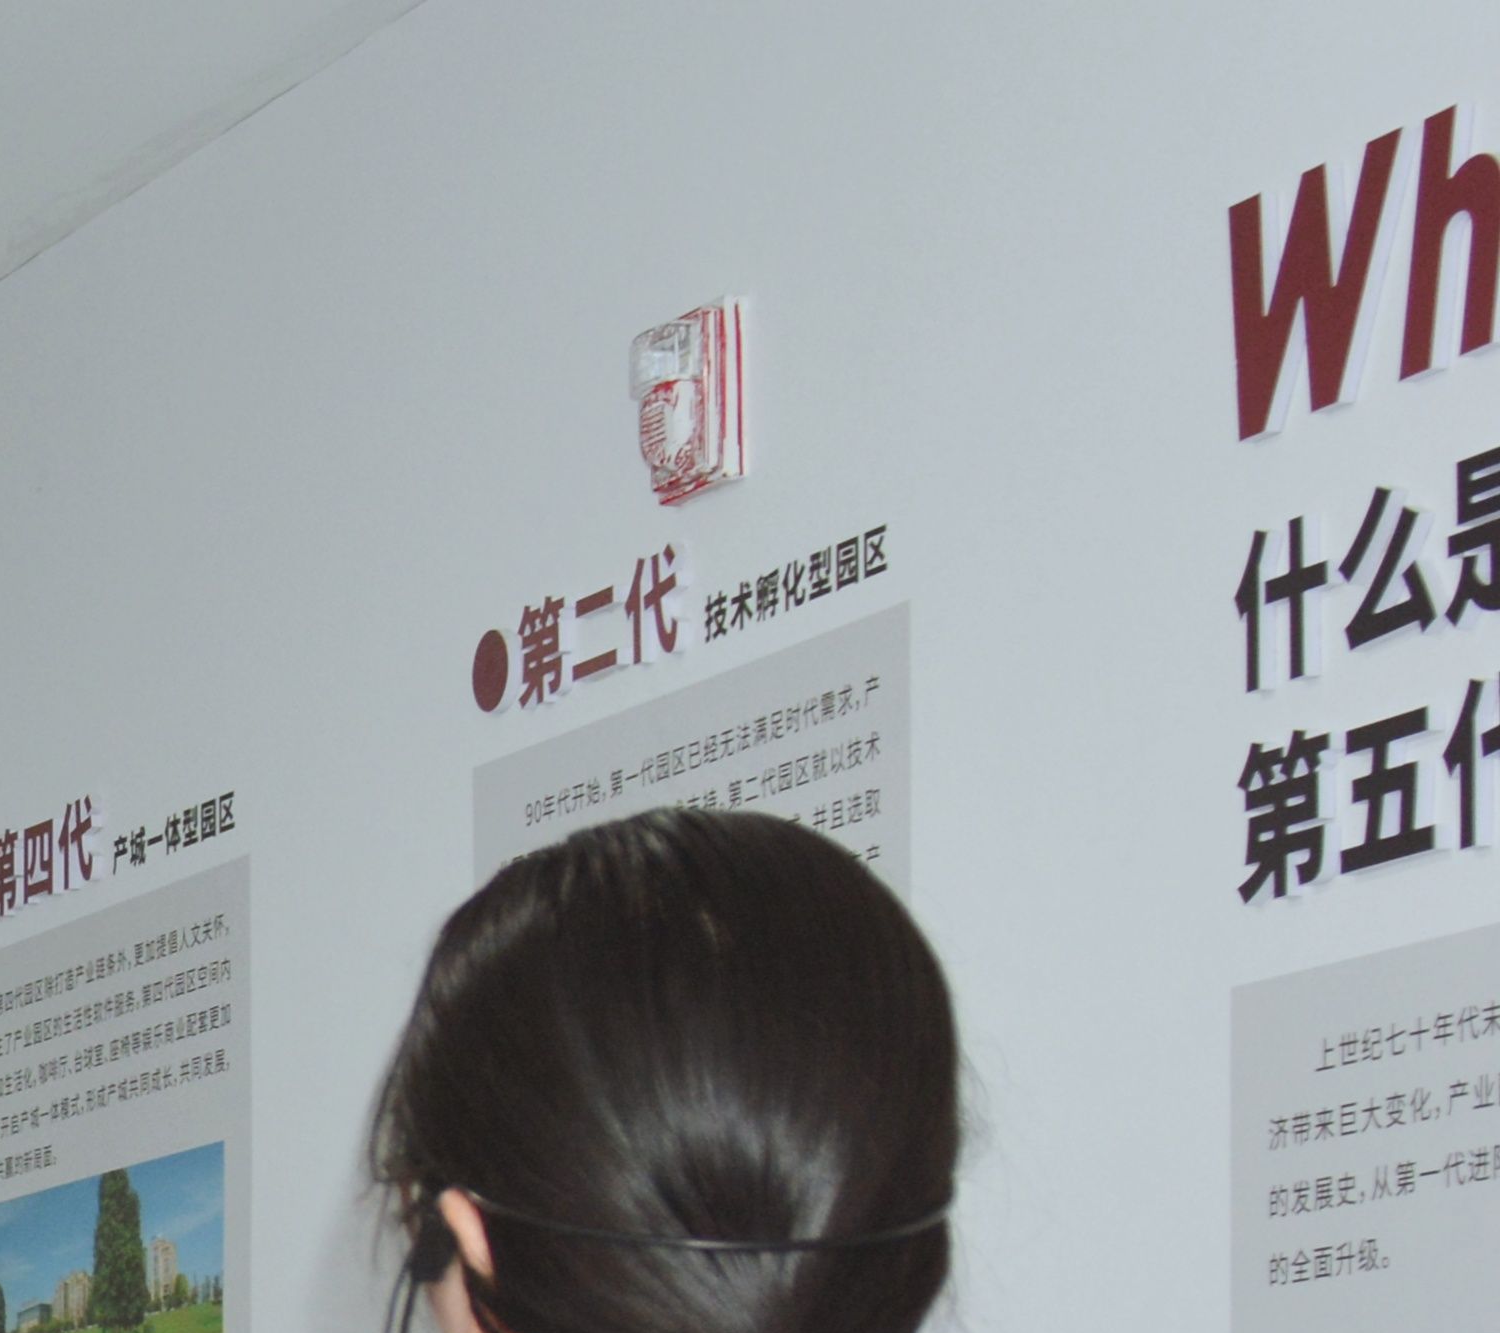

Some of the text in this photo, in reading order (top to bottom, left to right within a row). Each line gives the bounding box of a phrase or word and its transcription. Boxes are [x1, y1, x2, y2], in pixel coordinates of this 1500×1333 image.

[518, 524, 888, 709] 第二代 技术孵化型园区
[113, 791, 236, 875] 产城一体型园区
[1268, 1072, 1500, 1151] 济带来巨大变化，产业
[1268, 1239, 1390, 1287] 的全面升级。
